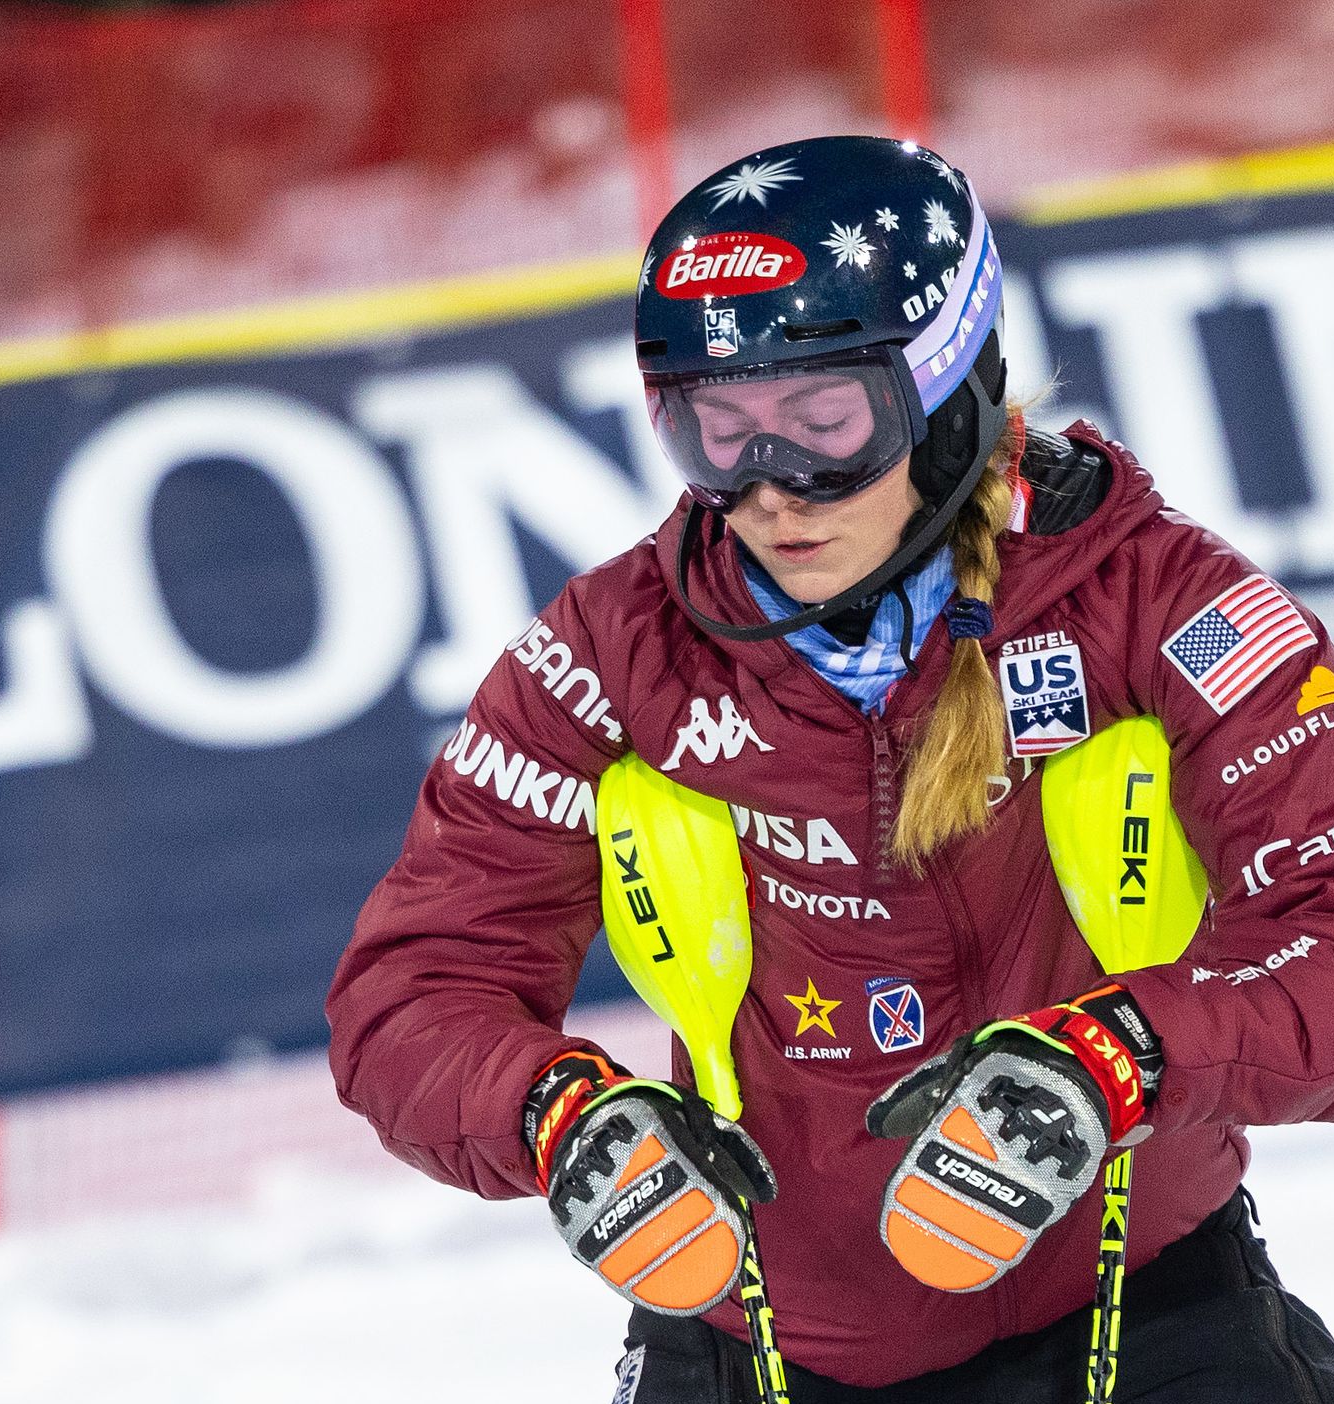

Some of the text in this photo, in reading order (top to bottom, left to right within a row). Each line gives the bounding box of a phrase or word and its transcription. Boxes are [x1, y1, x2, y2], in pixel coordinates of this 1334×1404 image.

[666, 245, 784, 289] Barilla
[706, 310, 734, 328] US
[1001, 630, 1073, 657] STIFEL
[1007, 654, 1077, 695] US
[1013, 687, 1080, 708] SKI TEAM
[1120, 773, 1154, 904] LEKI
[611, 828, 675, 963] LEKI
[761, 874, 891, 920] TOYOTA
[784, 1045, 852, 1060] U.S. ARMY
[1083, 1025, 1138, 1107] LEKI
[935, 1153, 1027, 1208] reusch
[1101, 1148, 1132, 1252] EKI
[593, 1171, 664, 1241] reusch
